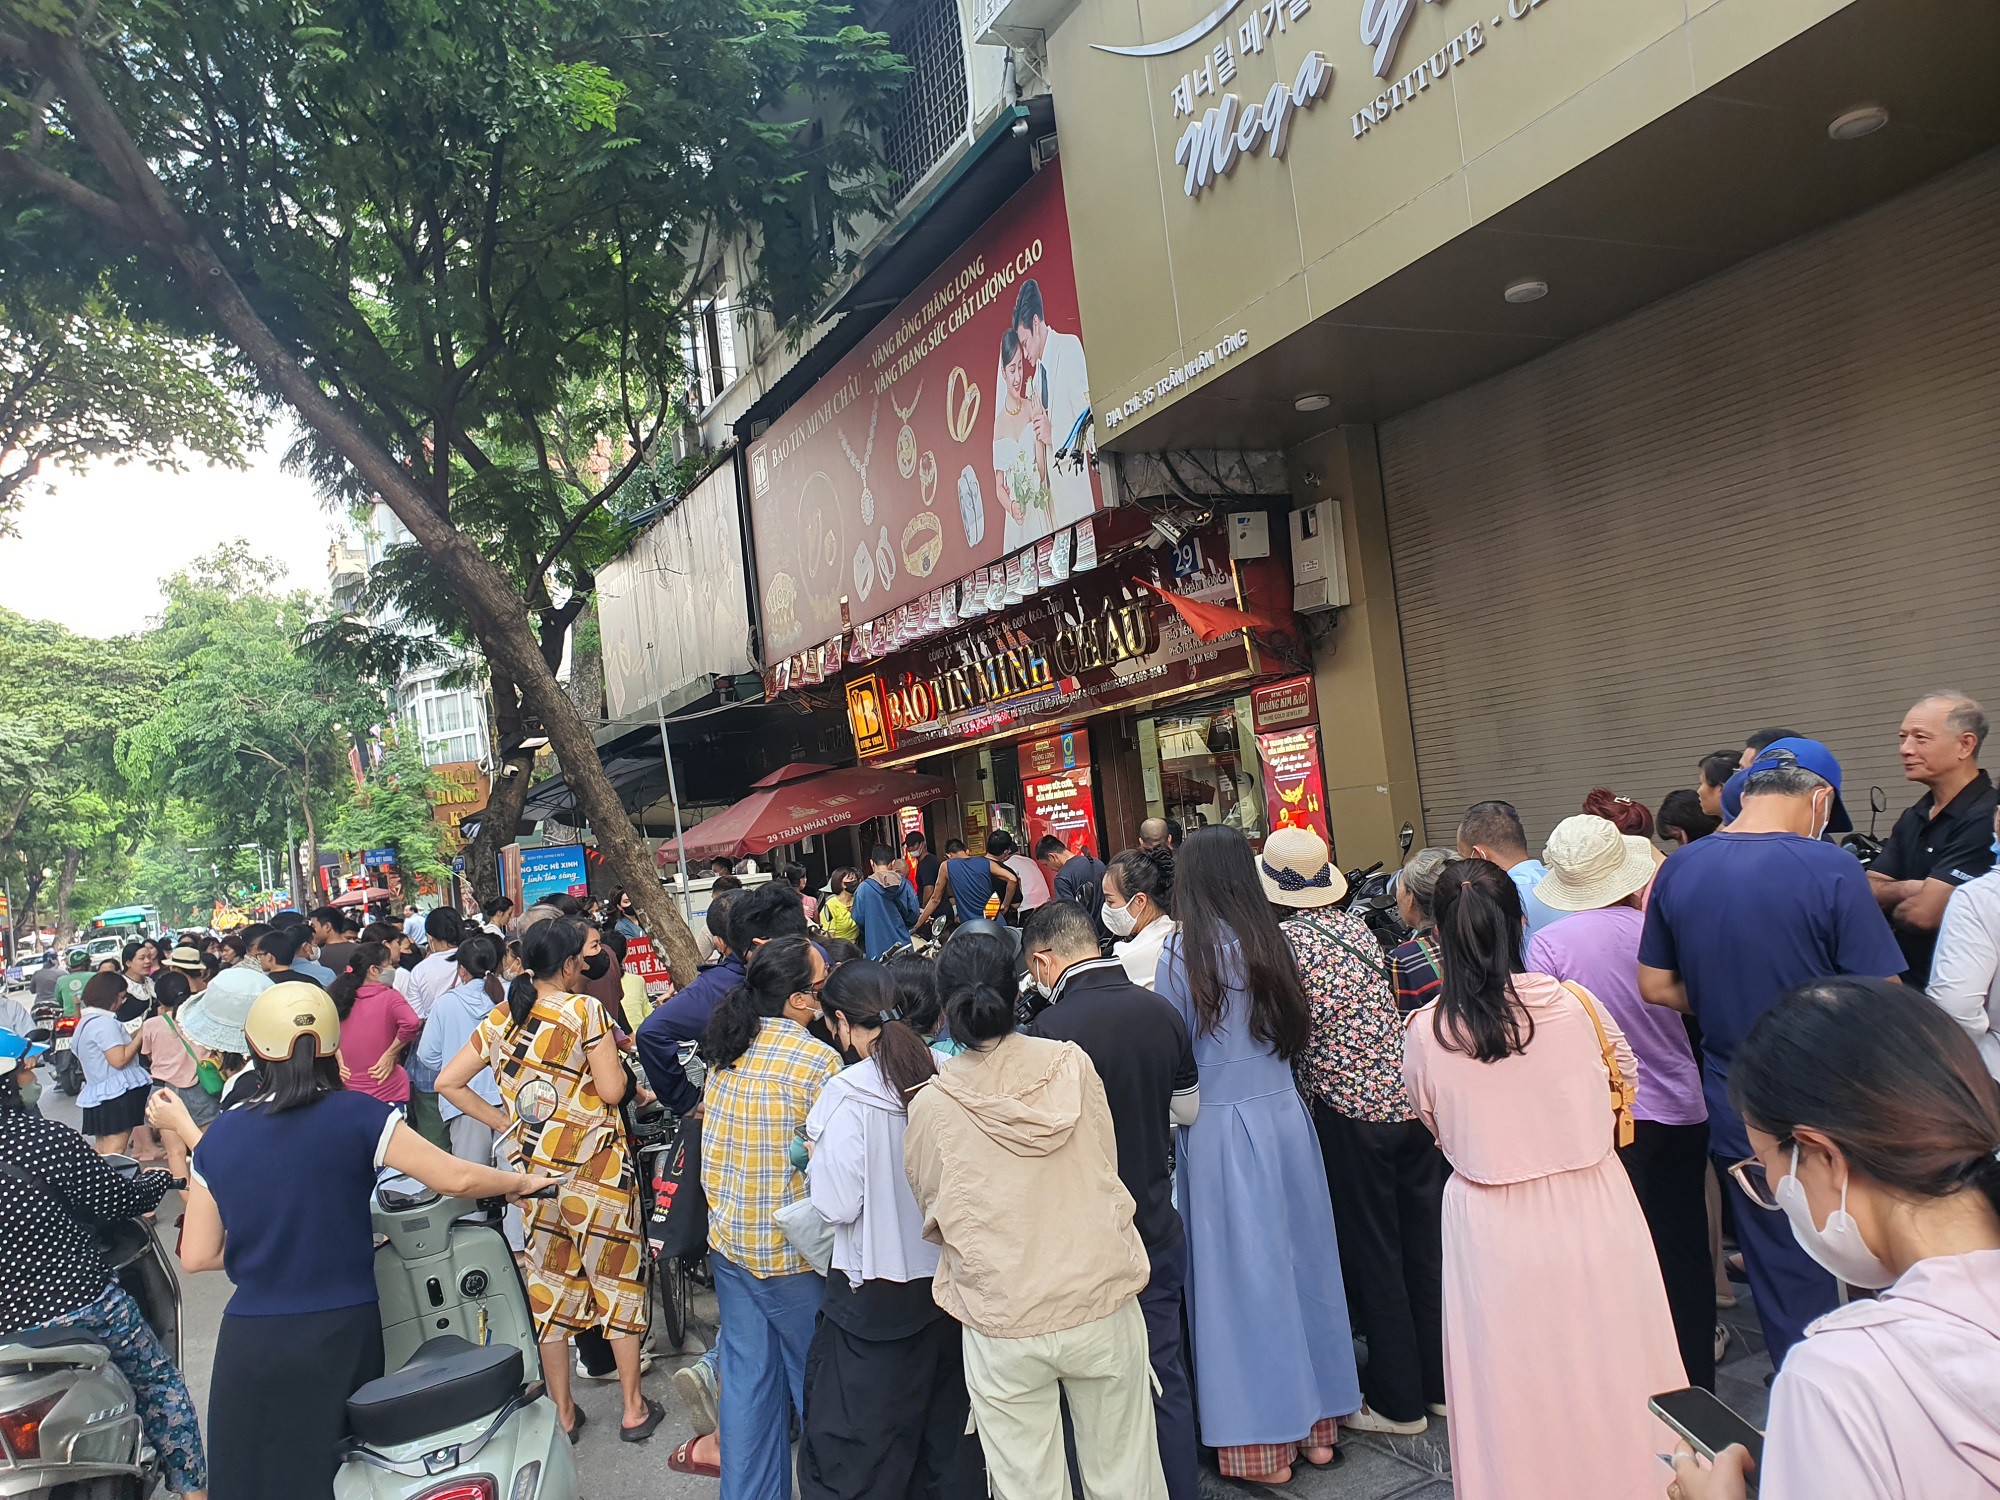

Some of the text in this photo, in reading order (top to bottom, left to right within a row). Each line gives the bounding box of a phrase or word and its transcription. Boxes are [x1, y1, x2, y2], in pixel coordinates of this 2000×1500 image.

[1350, 20, 1487, 139] INSTITUTE
[1175, 50, 1333, 197] Mega
[871, 337, 895, 369] VÀNG
[895, 318, 922, 349] RỒNG
[921, 291, 955, 327] THĂNG
[954, 254, 985, 297] LONG
[874, 364, 899, 396] VÀNG
[897, 337, 928, 376] TRANG
[929, 320, 949, 352] SỨC
[947, 293, 977, 333] CHẤT
[976, 261, 1015, 312] LƯỢNG
[1015, 238, 1043, 276] CAO
[1105, 407, 1123, 428] ĐỊA
[1142, 386, 1156, 406] 35
[1155, 367, 1185, 397] TRẦN
[1184, 350, 1215, 380] NHÂN
[1215, 328, 1249, 360] TÔNG
[771, 372, 862, 468] BẢO TÍN MINH CHÂU
[1173, 544, 1193, 572] 29
[886, 674, 929, 731] BẢO
[930, 664, 974, 712] TÍN
[974, 638, 1053, 704] MINH
[1055, 596, 1150, 677] CHÂU
[1203, 650, 1219, 662] 1989
[1259, 691, 1307, 712] HOÀNG KIM BẢO
[1263, 709, 1303, 722] PURE GOLD JEWELRY
[440, 765, 477, 785] RẦM
[892, 787, 941, 805] www.btmc.vn
[767, 833, 778, 844] 29
[778, 825, 803, 840] TRẦN
[803, 816, 828, 833] NHÂN
[828, 810, 852, 823] TÔNG
[533, 863, 549, 872] SỨC
[550, 862, 560, 870] HÈ
[560, 860, 579, 868] XINH
[627, 946, 636, 956] CH
[636, 944, 647, 954] VUI
[623, 961, 639, 975] NG
[653, 958, 667, 972] XE
[651, 1213, 666, 1223] HIP
